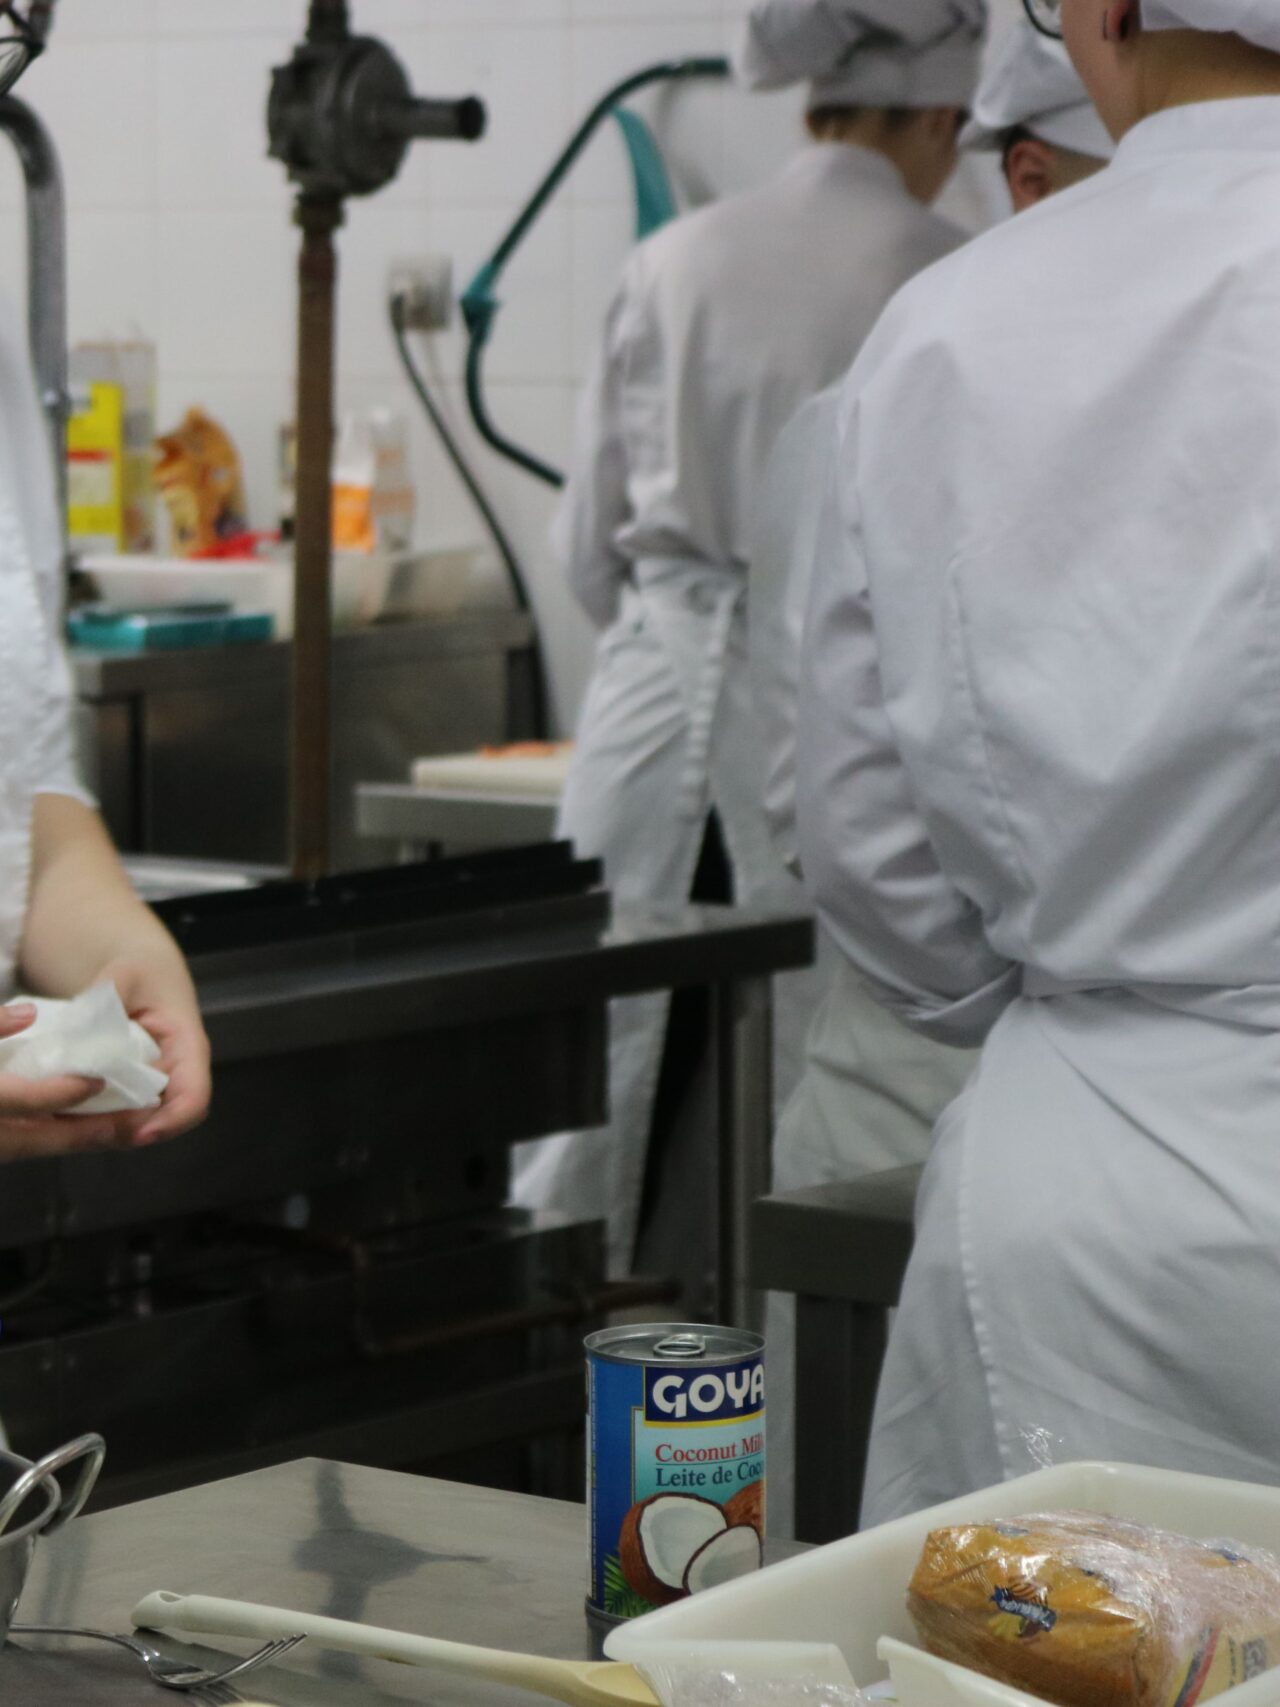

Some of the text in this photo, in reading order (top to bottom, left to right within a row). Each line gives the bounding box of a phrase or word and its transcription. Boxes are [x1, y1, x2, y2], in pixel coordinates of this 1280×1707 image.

[652, 1363, 764, 1418] GOYA
[655, 1442, 737, 1463] Coconut
[655, 1467, 706, 1487] Leite
[712, 1465, 733, 1485] de
